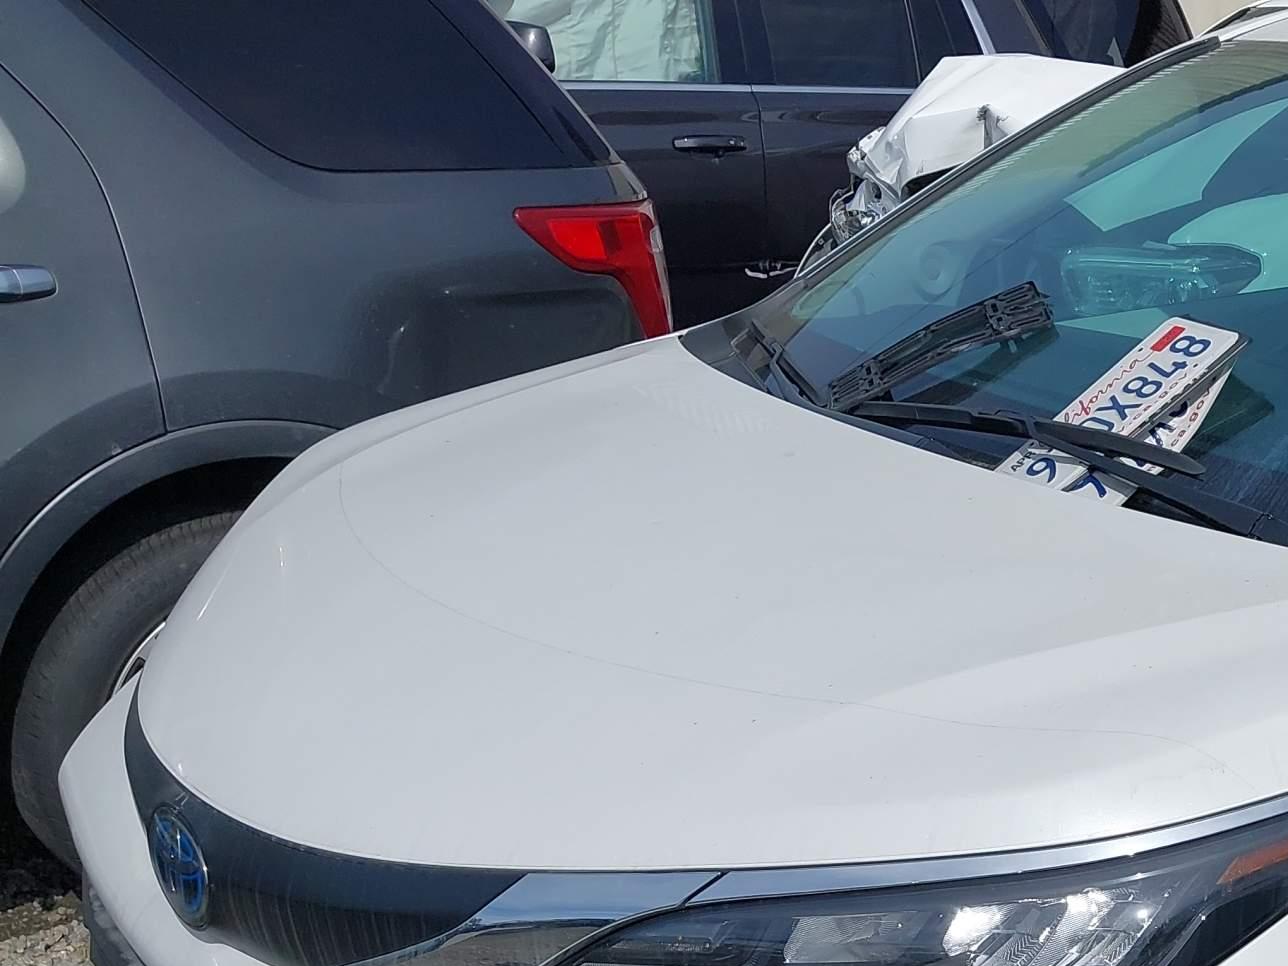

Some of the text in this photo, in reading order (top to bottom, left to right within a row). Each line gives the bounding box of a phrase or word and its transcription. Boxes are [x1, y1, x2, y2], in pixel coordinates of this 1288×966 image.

[1117, 372, 1189, 434] v.ca.gov
[1170, 386, 1211, 448] ca.gov
[1010, 451, 1037, 473] APR
